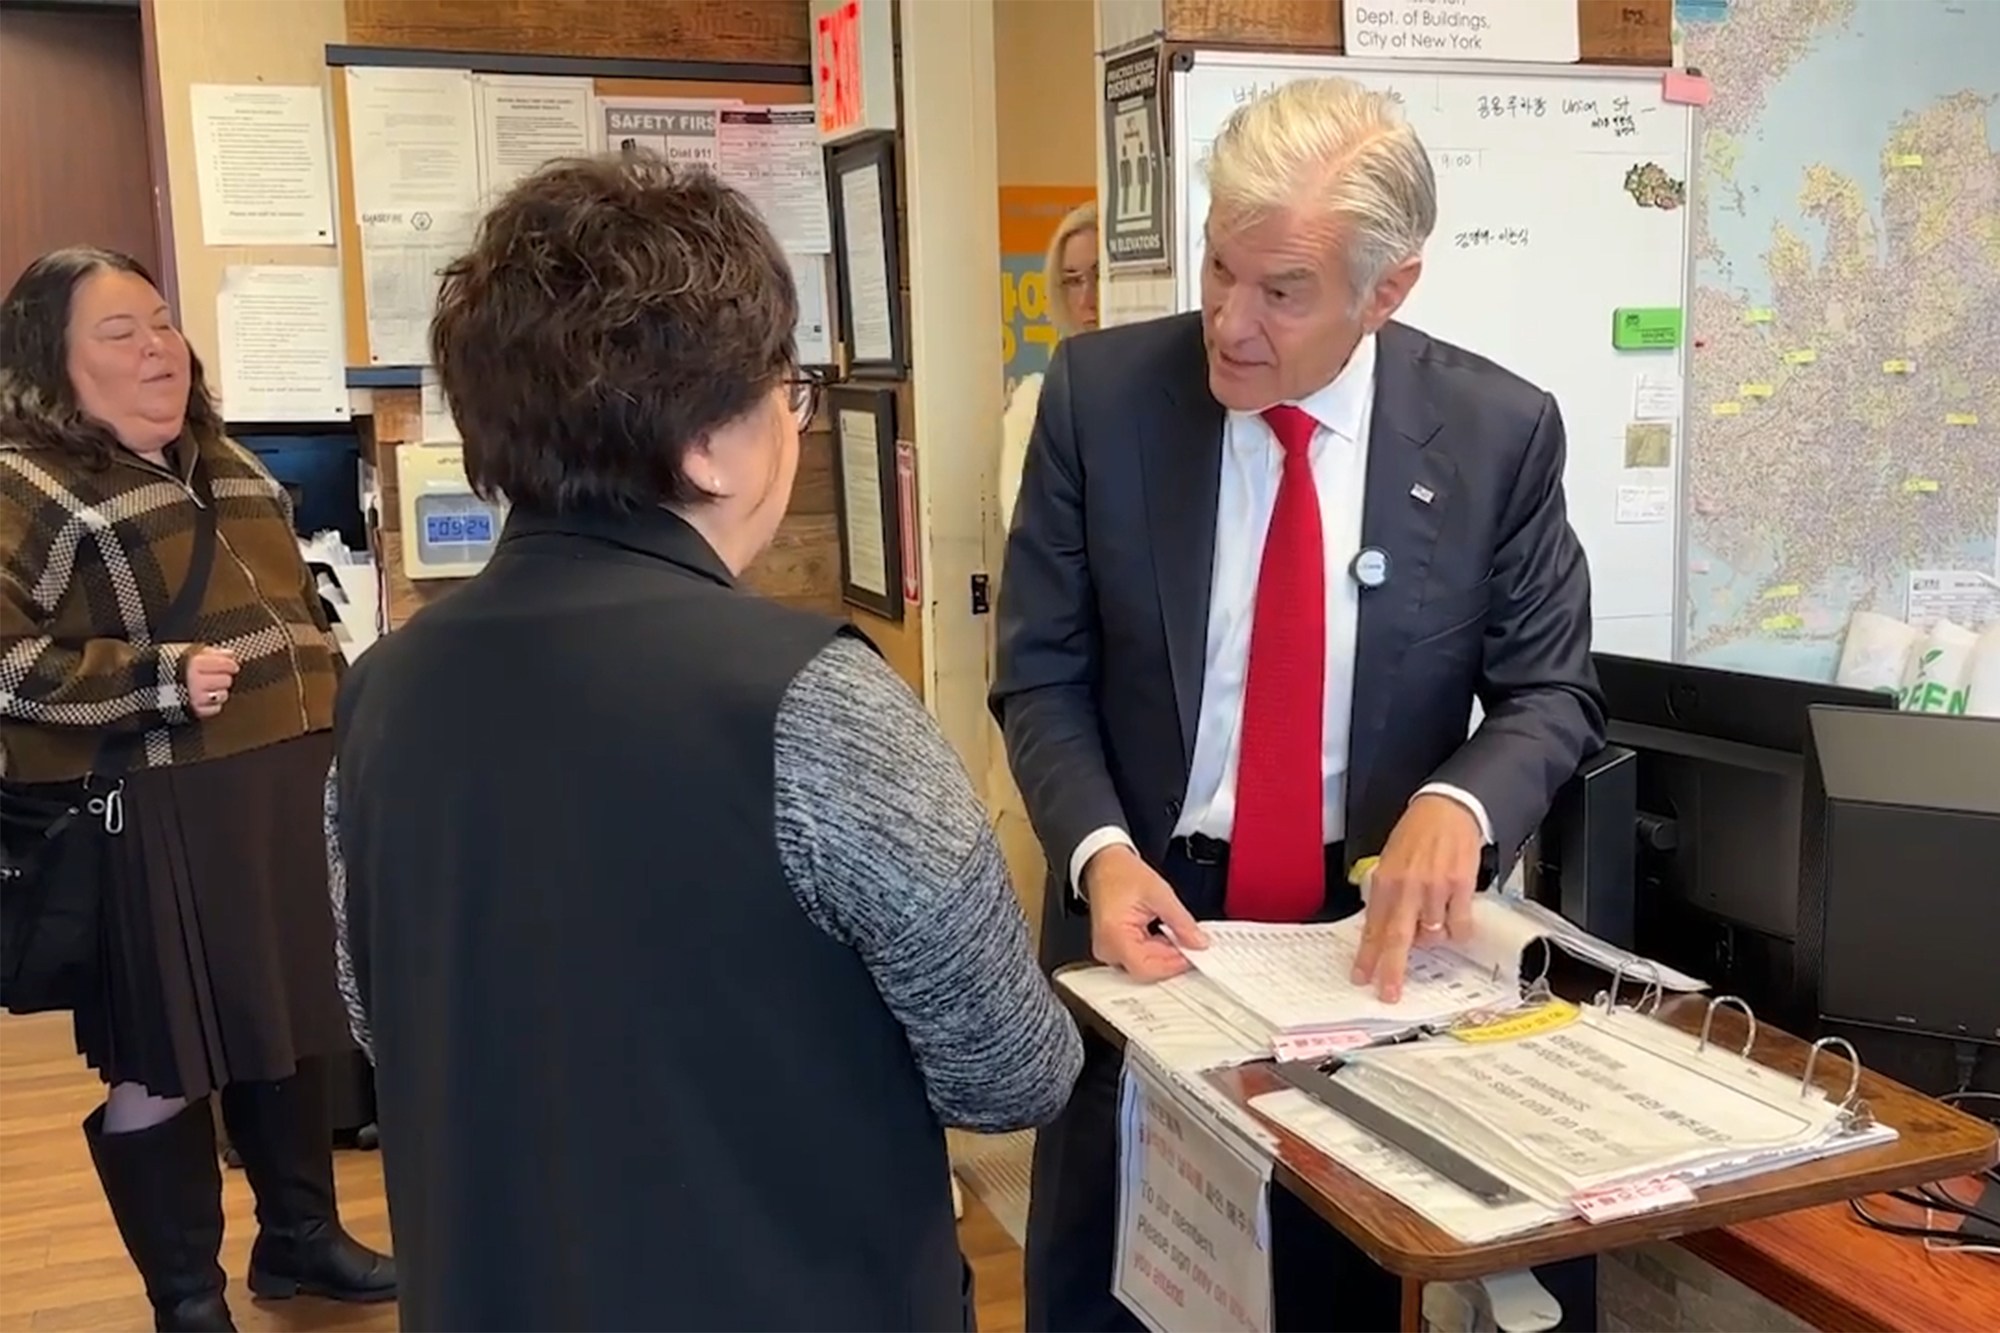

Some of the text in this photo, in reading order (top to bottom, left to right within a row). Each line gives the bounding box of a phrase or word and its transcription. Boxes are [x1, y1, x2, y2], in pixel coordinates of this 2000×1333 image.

[1356, 7, 1399, 26] Dept.
[1402, 10, 1418, 26] of
[1357, 30, 1482, 50] City of New York
[610, 114, 674, 129] SAFETY
[679, 115, 714, 131] FIRS
[694, 148, 711, 159] 911
[1137, 1213, 1169, 1255] Please
